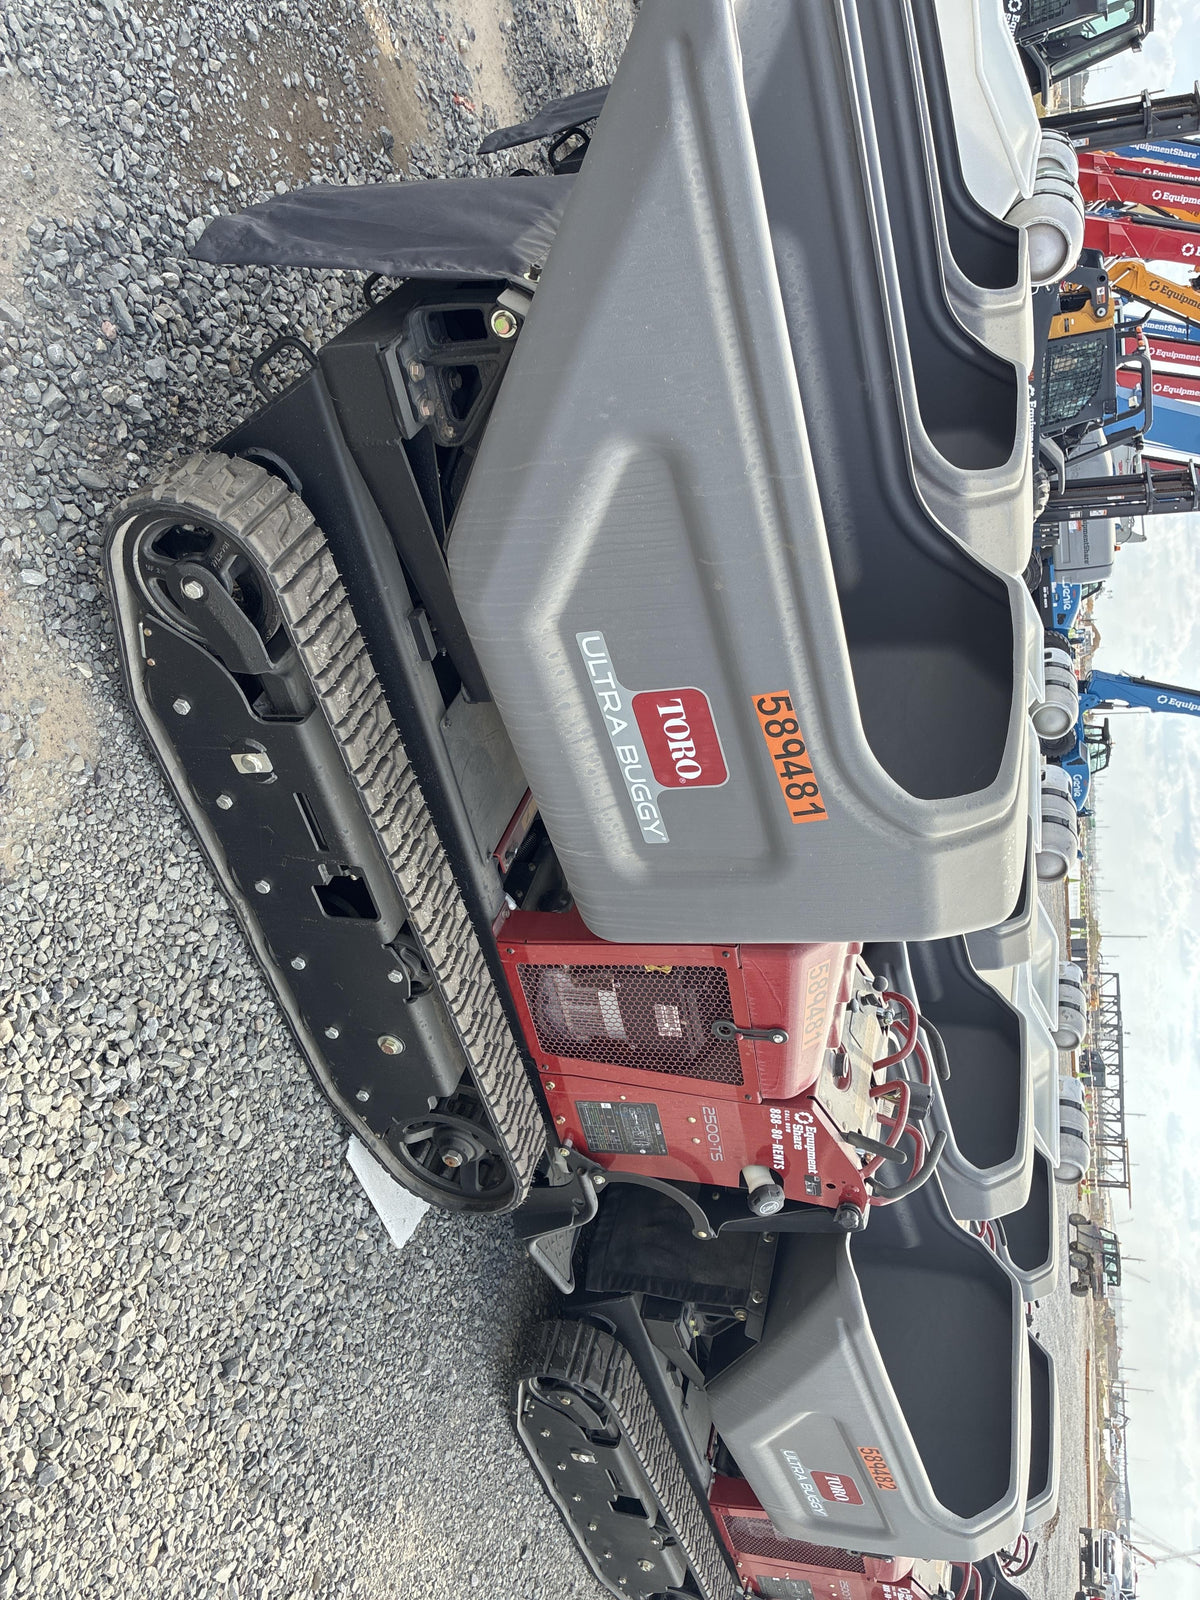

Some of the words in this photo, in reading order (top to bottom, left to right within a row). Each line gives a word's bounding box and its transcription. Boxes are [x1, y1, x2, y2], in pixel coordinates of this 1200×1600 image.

[581, 636, 628, 735] ULTRA
[616, 745, 665, 837] BUGGY
[656, 698, 702, 780] TORO
[757, 696, 826, 816] 589481
[1073, 774, 1083, 797] Genie
[804, 963, 829, 1045] 589481
[770, 1108, 784, 1170] 888-80-RENTS
[792, 1124, 803, 1150] Share
[804, 1126, 818, 1174] Equipment
[783, 1450, 807, 1480] ULTRA
[825, 1476, 850, 1502] TORO
[860, 1448, 897, 1490] 589482
